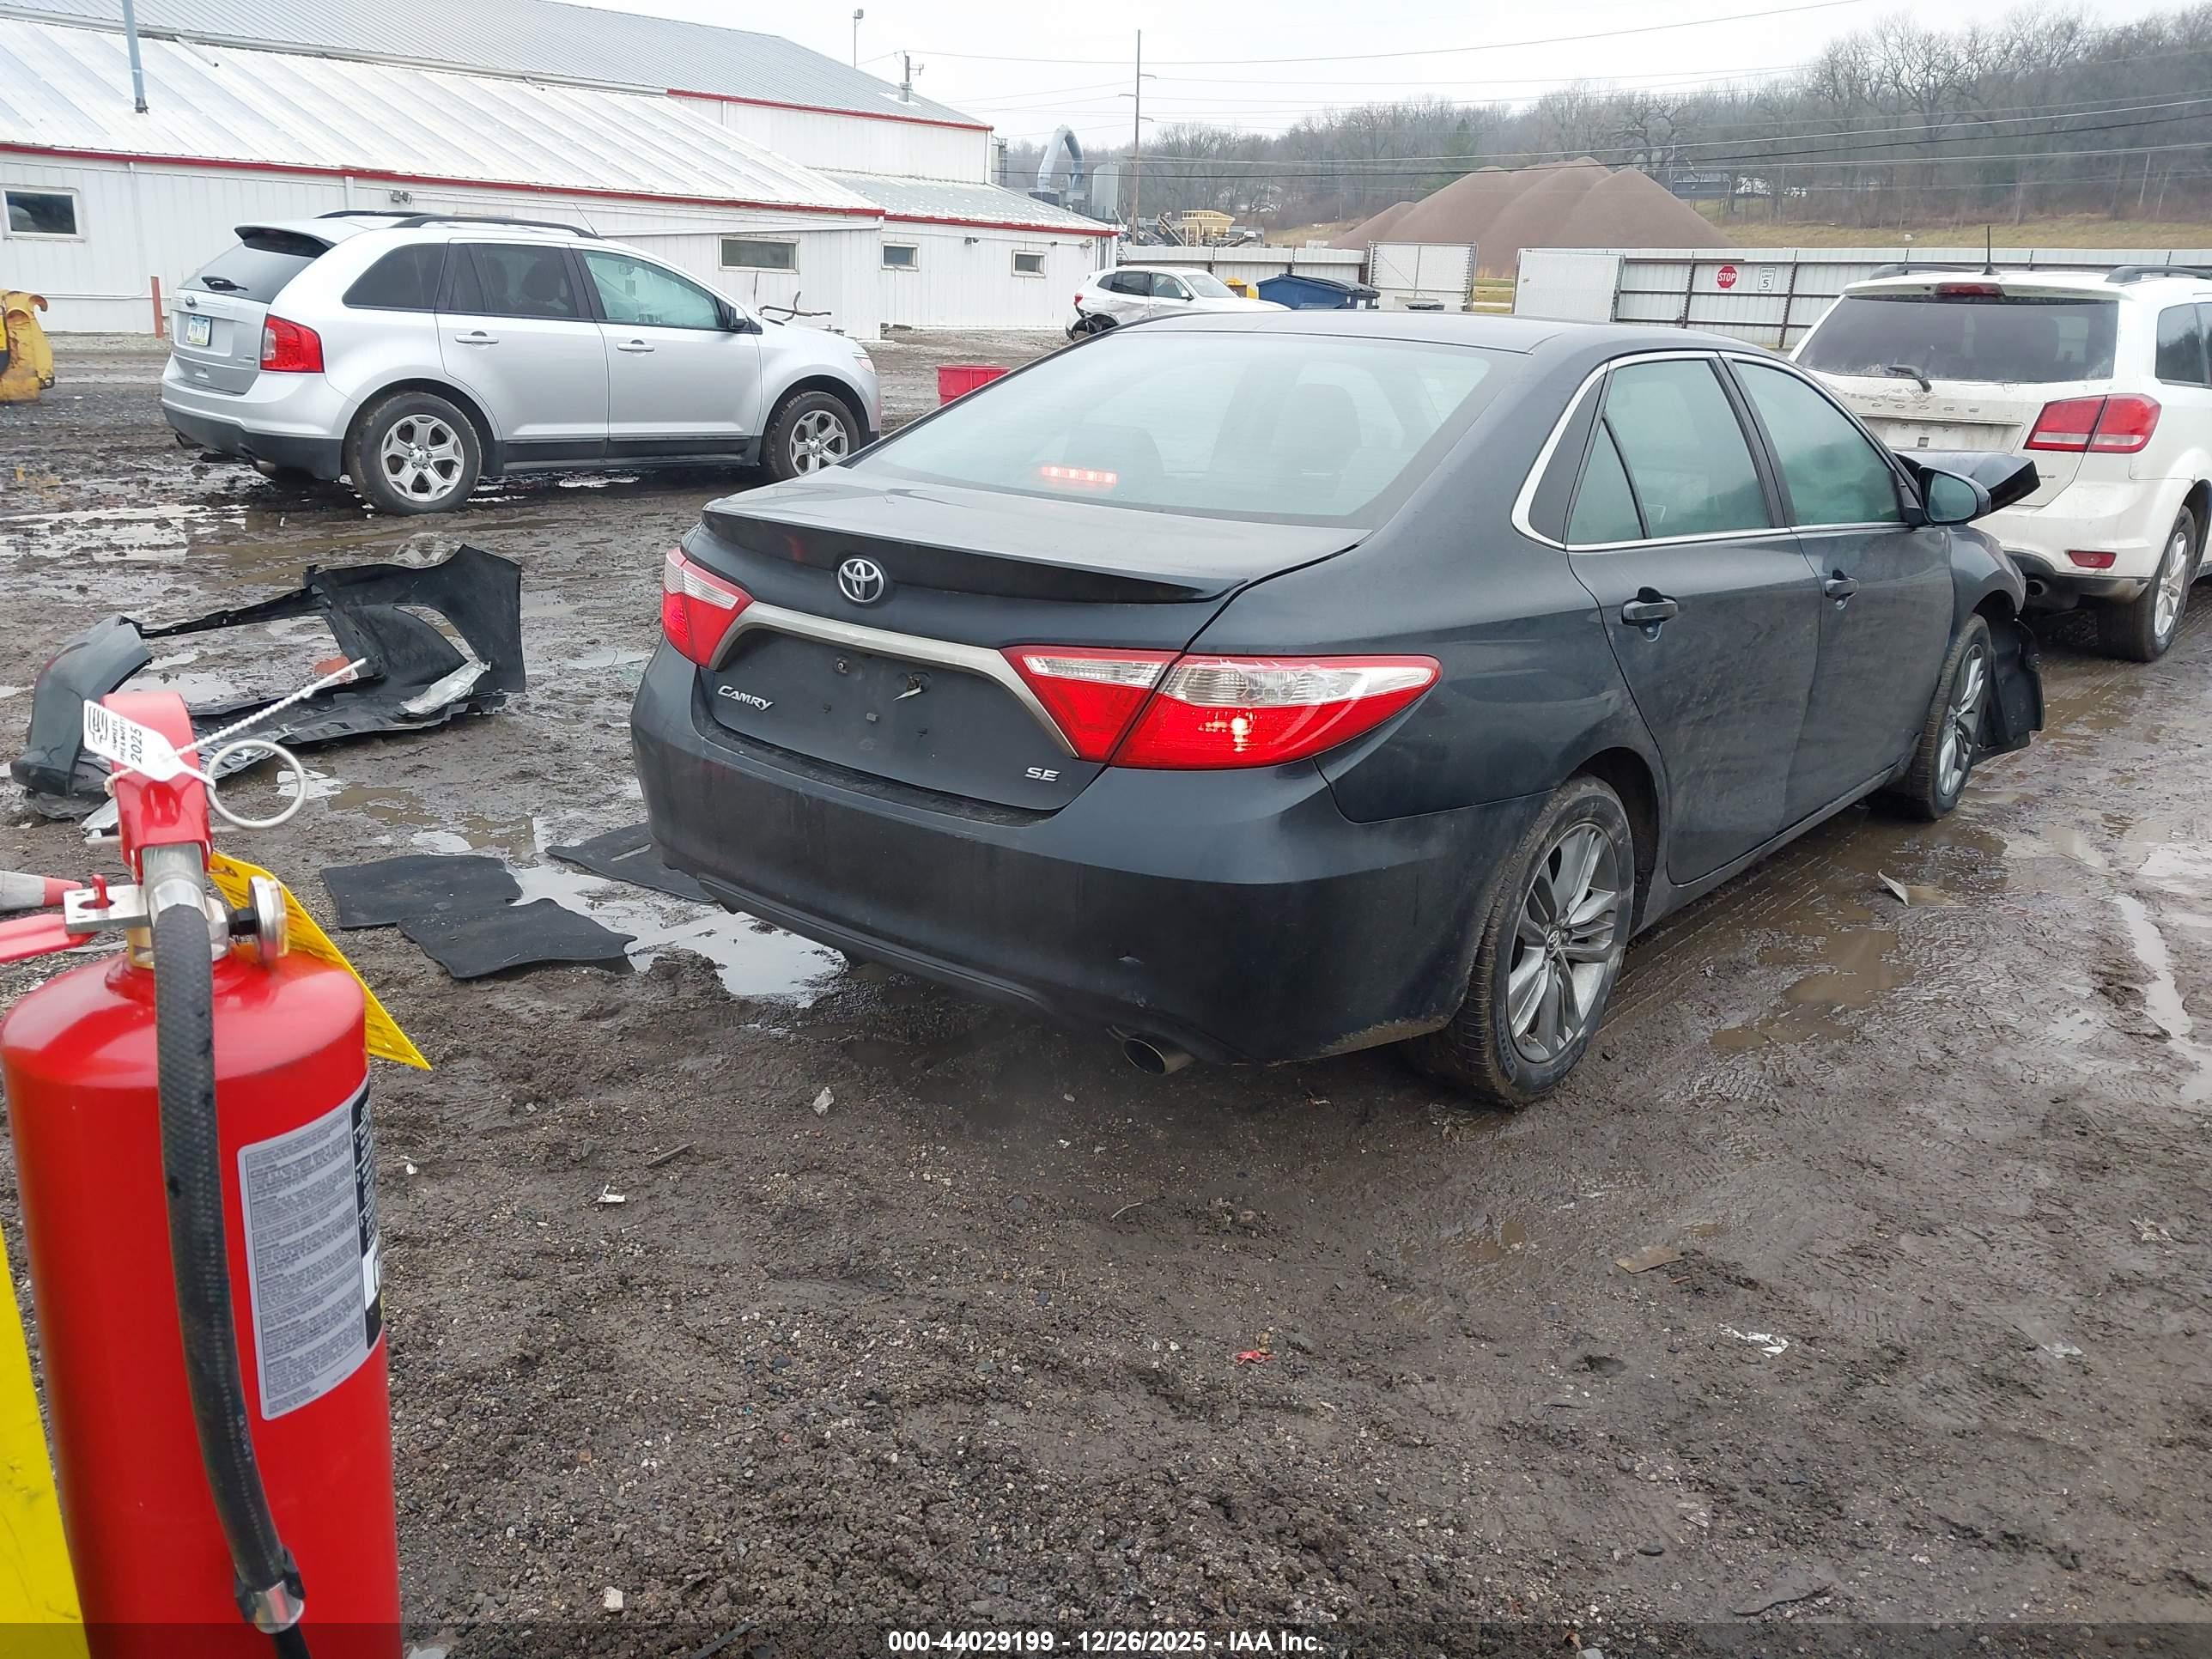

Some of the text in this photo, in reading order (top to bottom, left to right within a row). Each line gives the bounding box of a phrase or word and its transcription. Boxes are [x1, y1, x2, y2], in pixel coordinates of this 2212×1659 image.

[1717, 272, 1736, 283] STOP
[1762, 279, 1770, 288] 5
[1871, 402, 1980, 413] DODGE
[717, 685, 775, 711] CAMRY
[131, 726, 142, 764] 2025
[1024, 766, 1060, 782] SE
